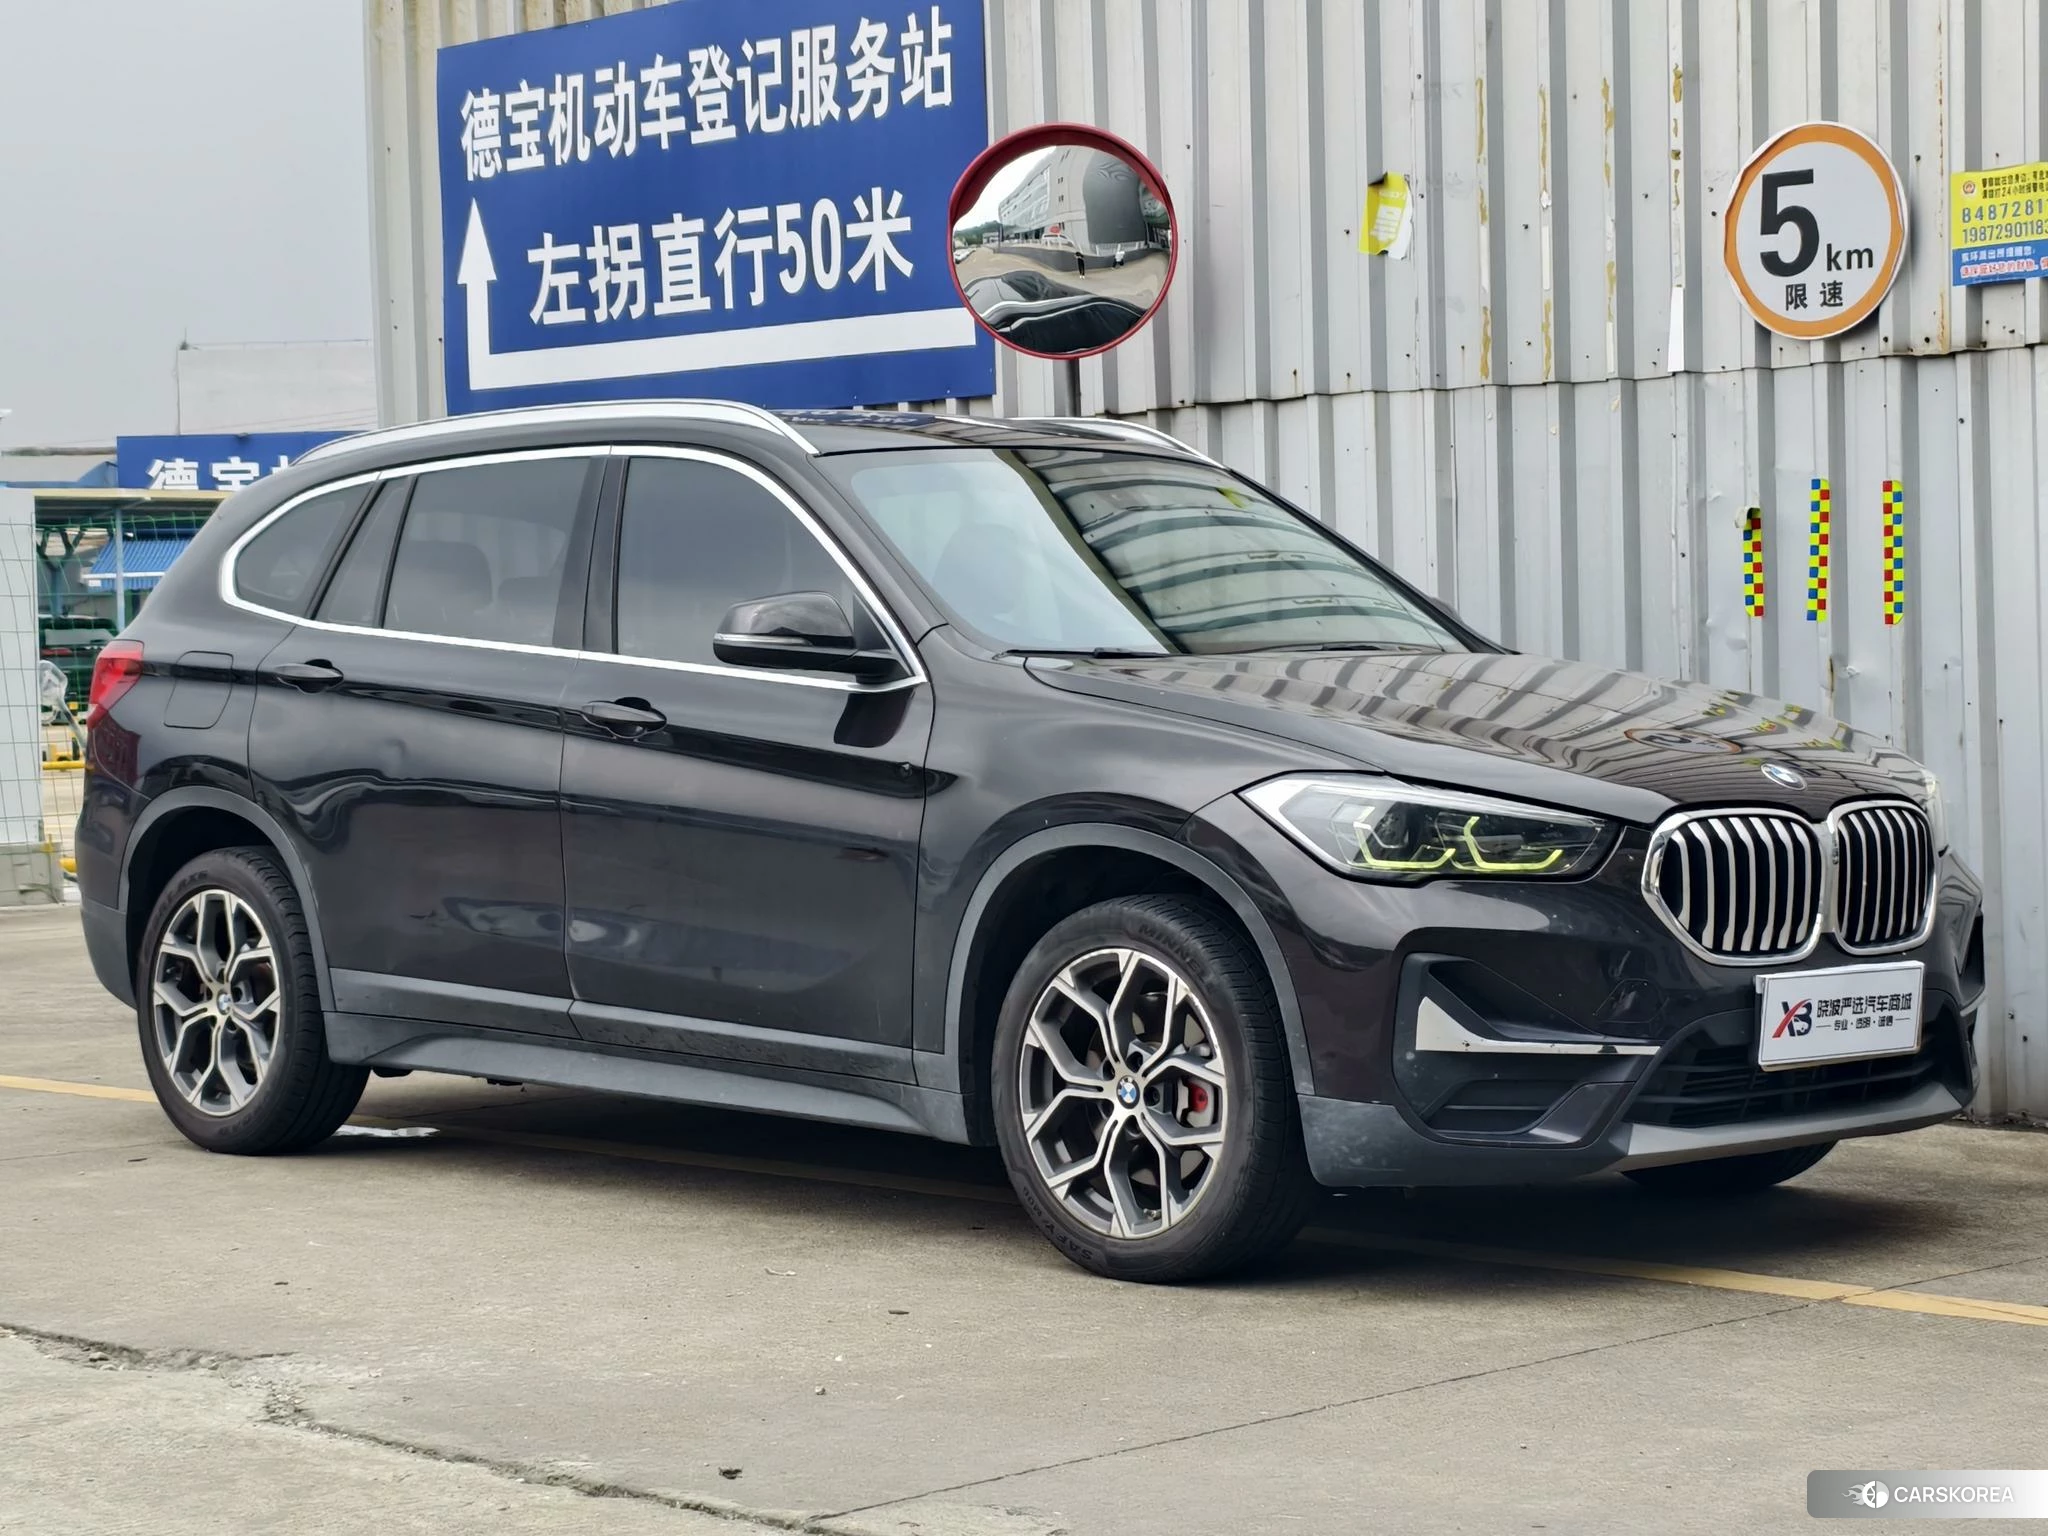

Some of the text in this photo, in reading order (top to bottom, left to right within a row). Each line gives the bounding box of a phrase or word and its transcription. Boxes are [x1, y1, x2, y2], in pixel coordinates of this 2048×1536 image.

[460, 5, 953, 182] 德宝机动车登记服务站
[527, 186, 914, 325] 左拐直行50米
[1760, 168, 1874, 277] 5 km
[1962, 198, 2048, 223] 8487281
[1786, 280, 1843, 311] 限速
